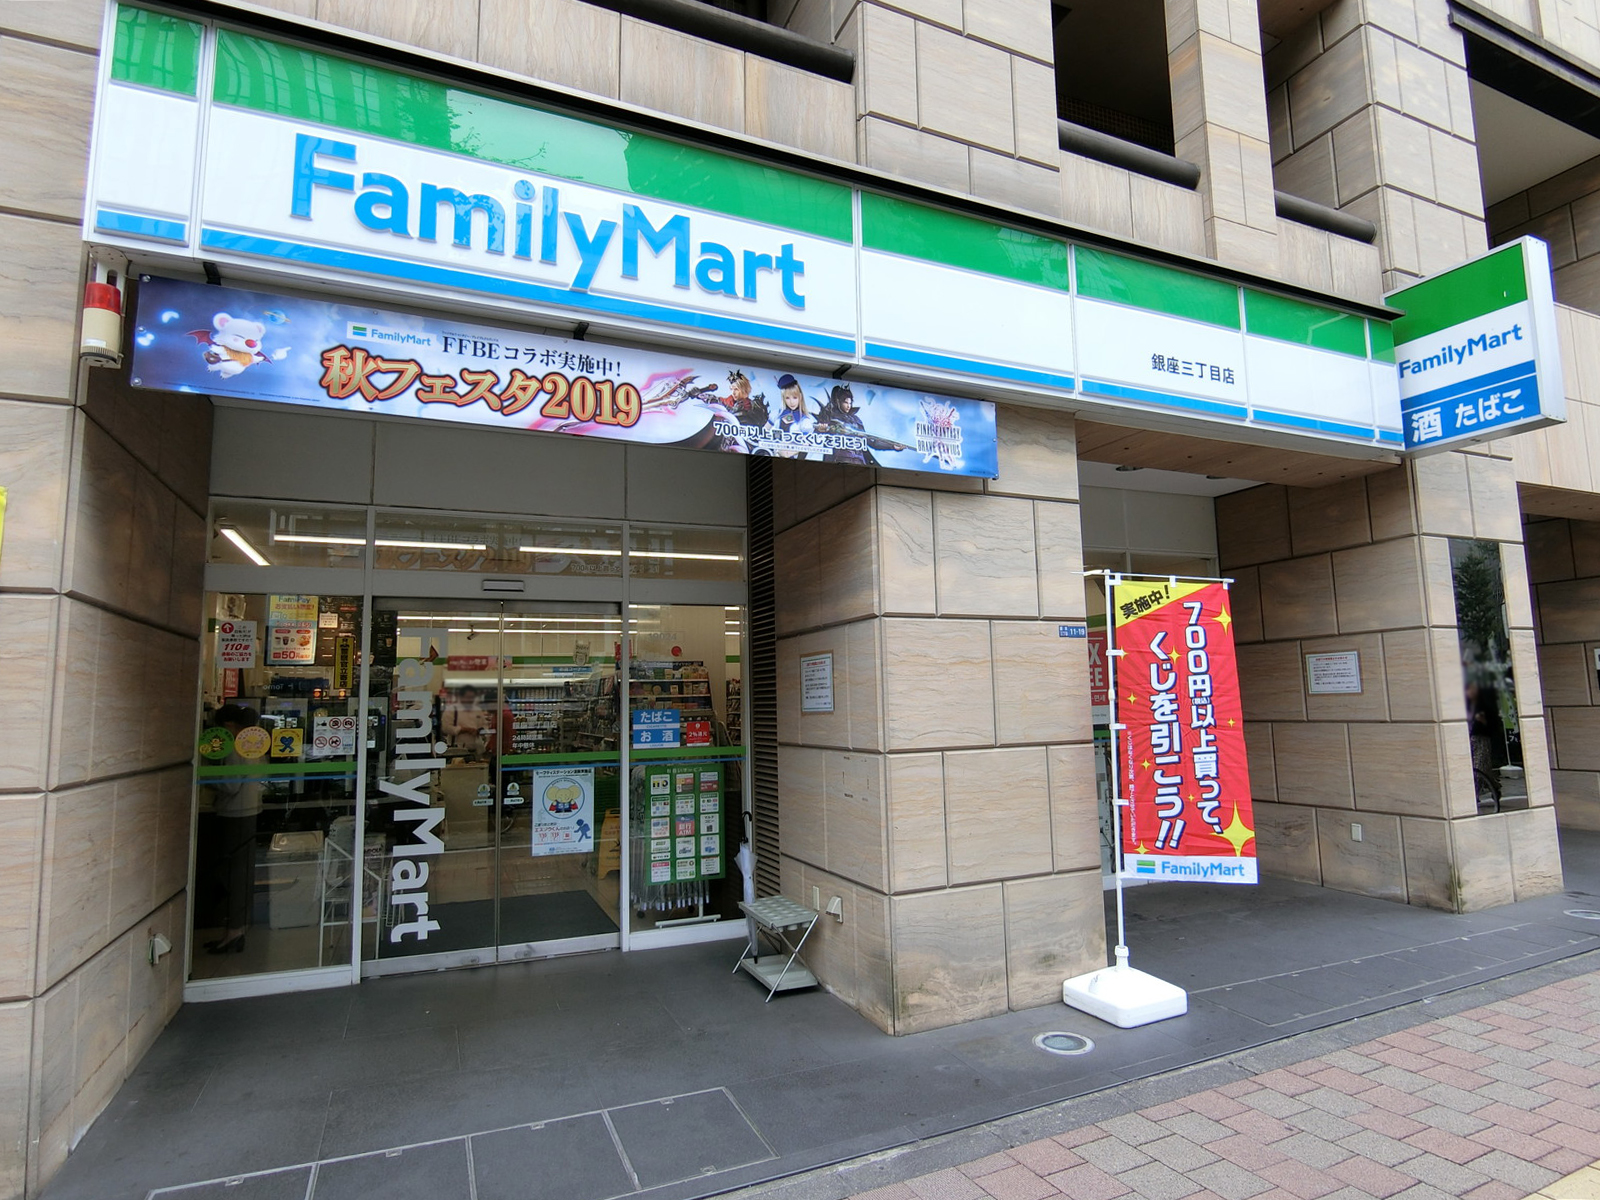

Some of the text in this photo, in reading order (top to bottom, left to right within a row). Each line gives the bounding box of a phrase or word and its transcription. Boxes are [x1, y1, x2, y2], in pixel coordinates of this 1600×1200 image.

[290, 133, 806, 312] FamilyMart
[371, 328, 431, 346] FamilyMart
[442, 336, 500, 360] FFBE
[504, 345, 621, 377] コラボ実施中!
[1399, 324, 1523, 378] FamilyMart
[320, 345, 642, 428] 秋フェスタ2019
[1152, 353, 1235, 385] 銀座三丁目店
[1411, 388, 1525, 443] 酒 たばこ
[1120, 584, 1170, 620] 実施中!
[640, 711, 673, 723] たばこ
[379, 627, 448, 943] FamilyMart
[1161, 861, 1245, 877] FamilyMart
